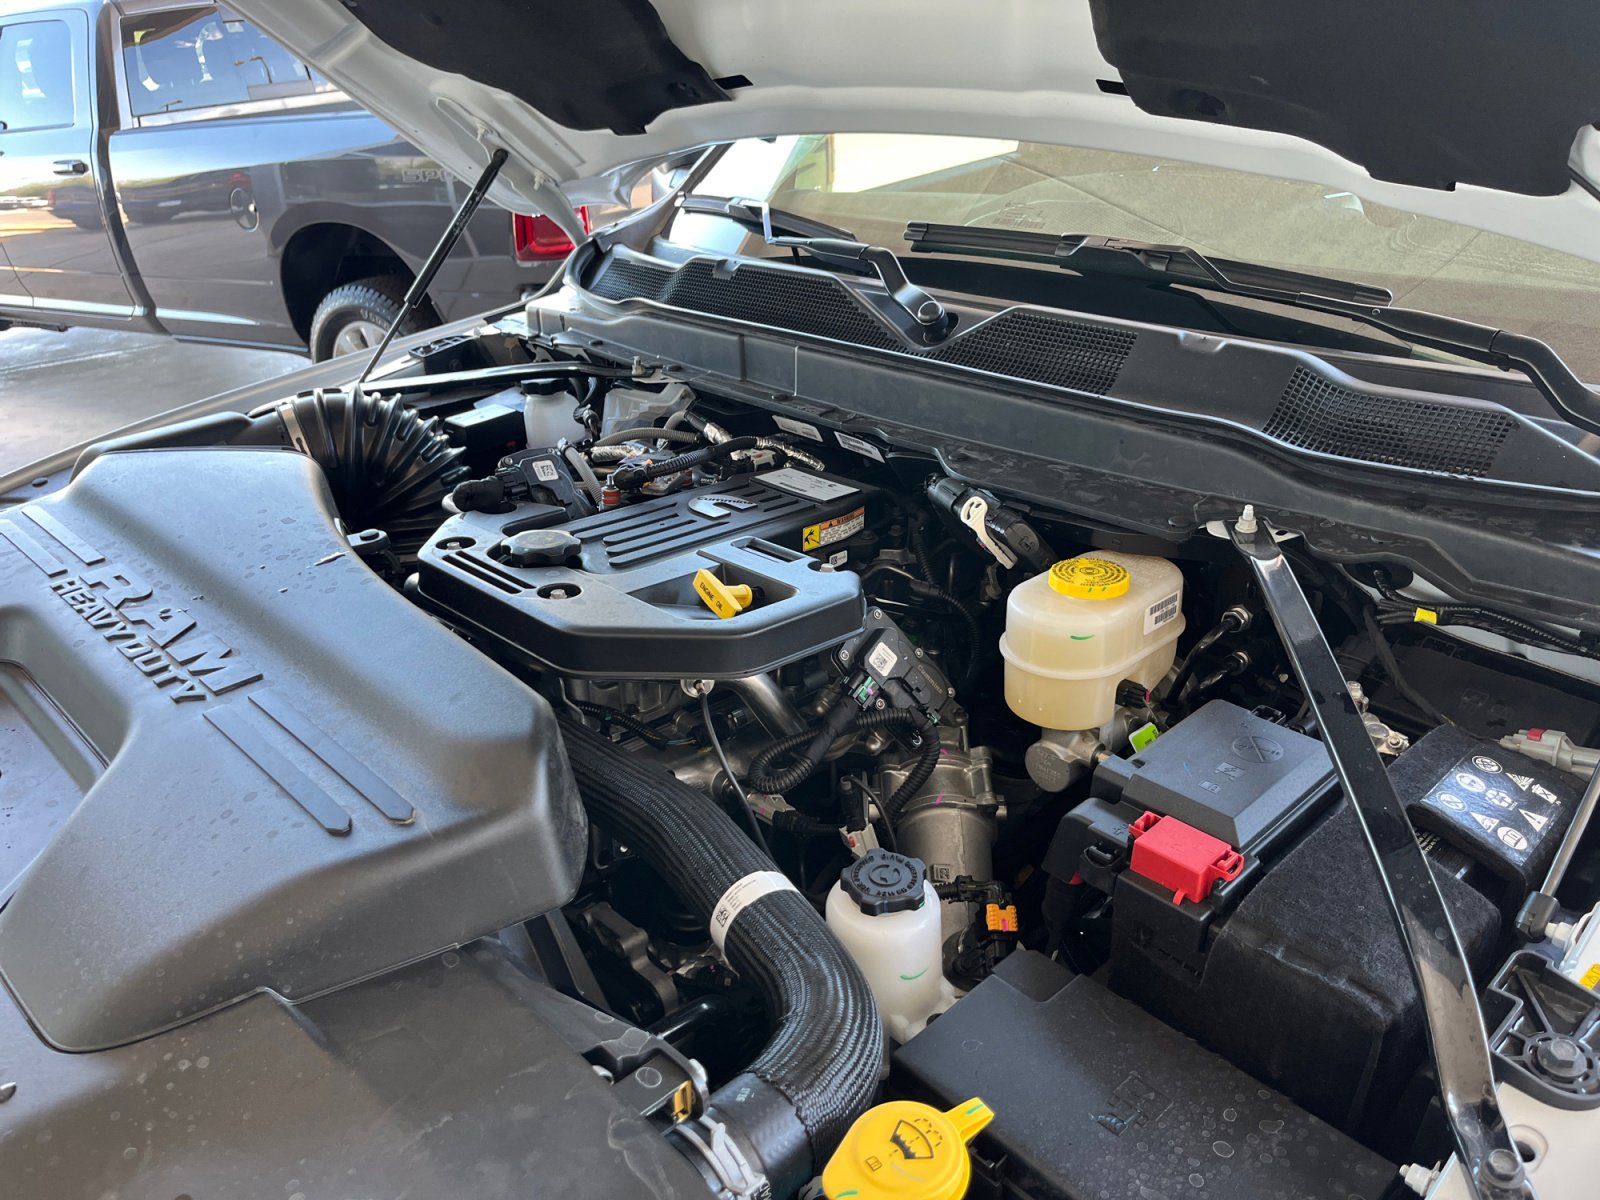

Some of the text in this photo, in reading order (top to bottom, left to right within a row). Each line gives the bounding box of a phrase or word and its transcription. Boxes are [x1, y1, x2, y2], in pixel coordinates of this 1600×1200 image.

[79, 563, 263, 696] RAM
[699, 581, 723, 611] ENGINE OIL
[51, 577, 206, 704] HEAVY DUTY
[918, 665, 943, 694] Cummins
